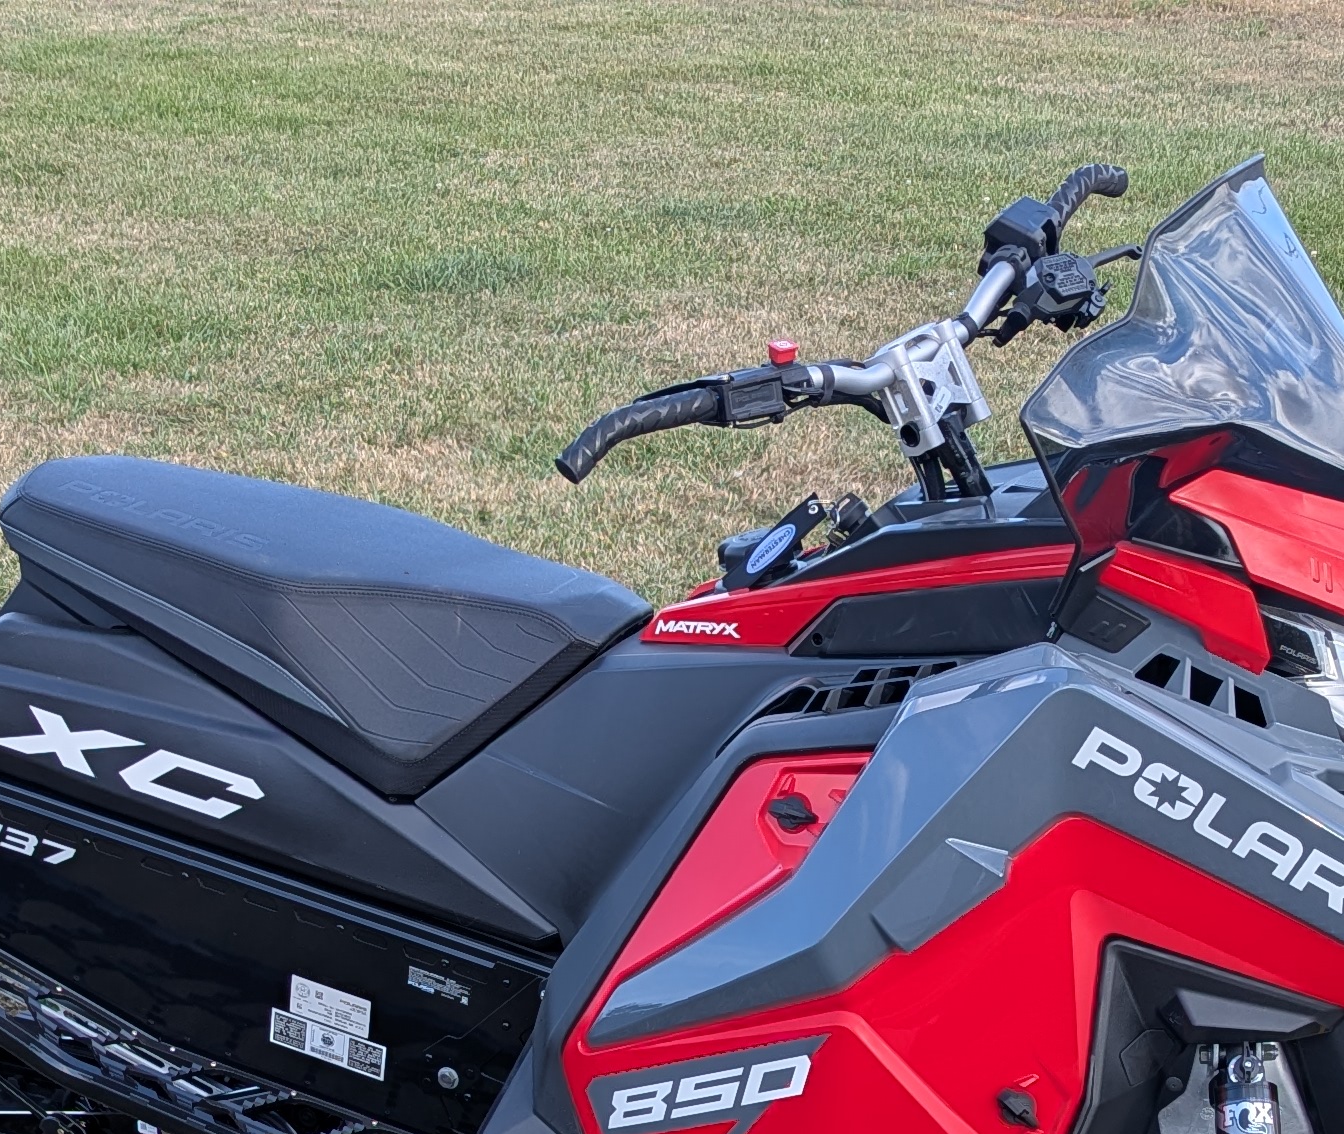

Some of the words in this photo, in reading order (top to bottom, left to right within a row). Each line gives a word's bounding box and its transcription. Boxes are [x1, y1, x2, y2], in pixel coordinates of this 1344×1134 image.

[57, 479, 270, 549] POLARIS
[750, 529, 791, 569] CHESTERMAN
[654, 619, 741, 639] MATRYX
[1279, 644, 1317, 665] POLARIS
[608, 1054, 811, 1129] 850
